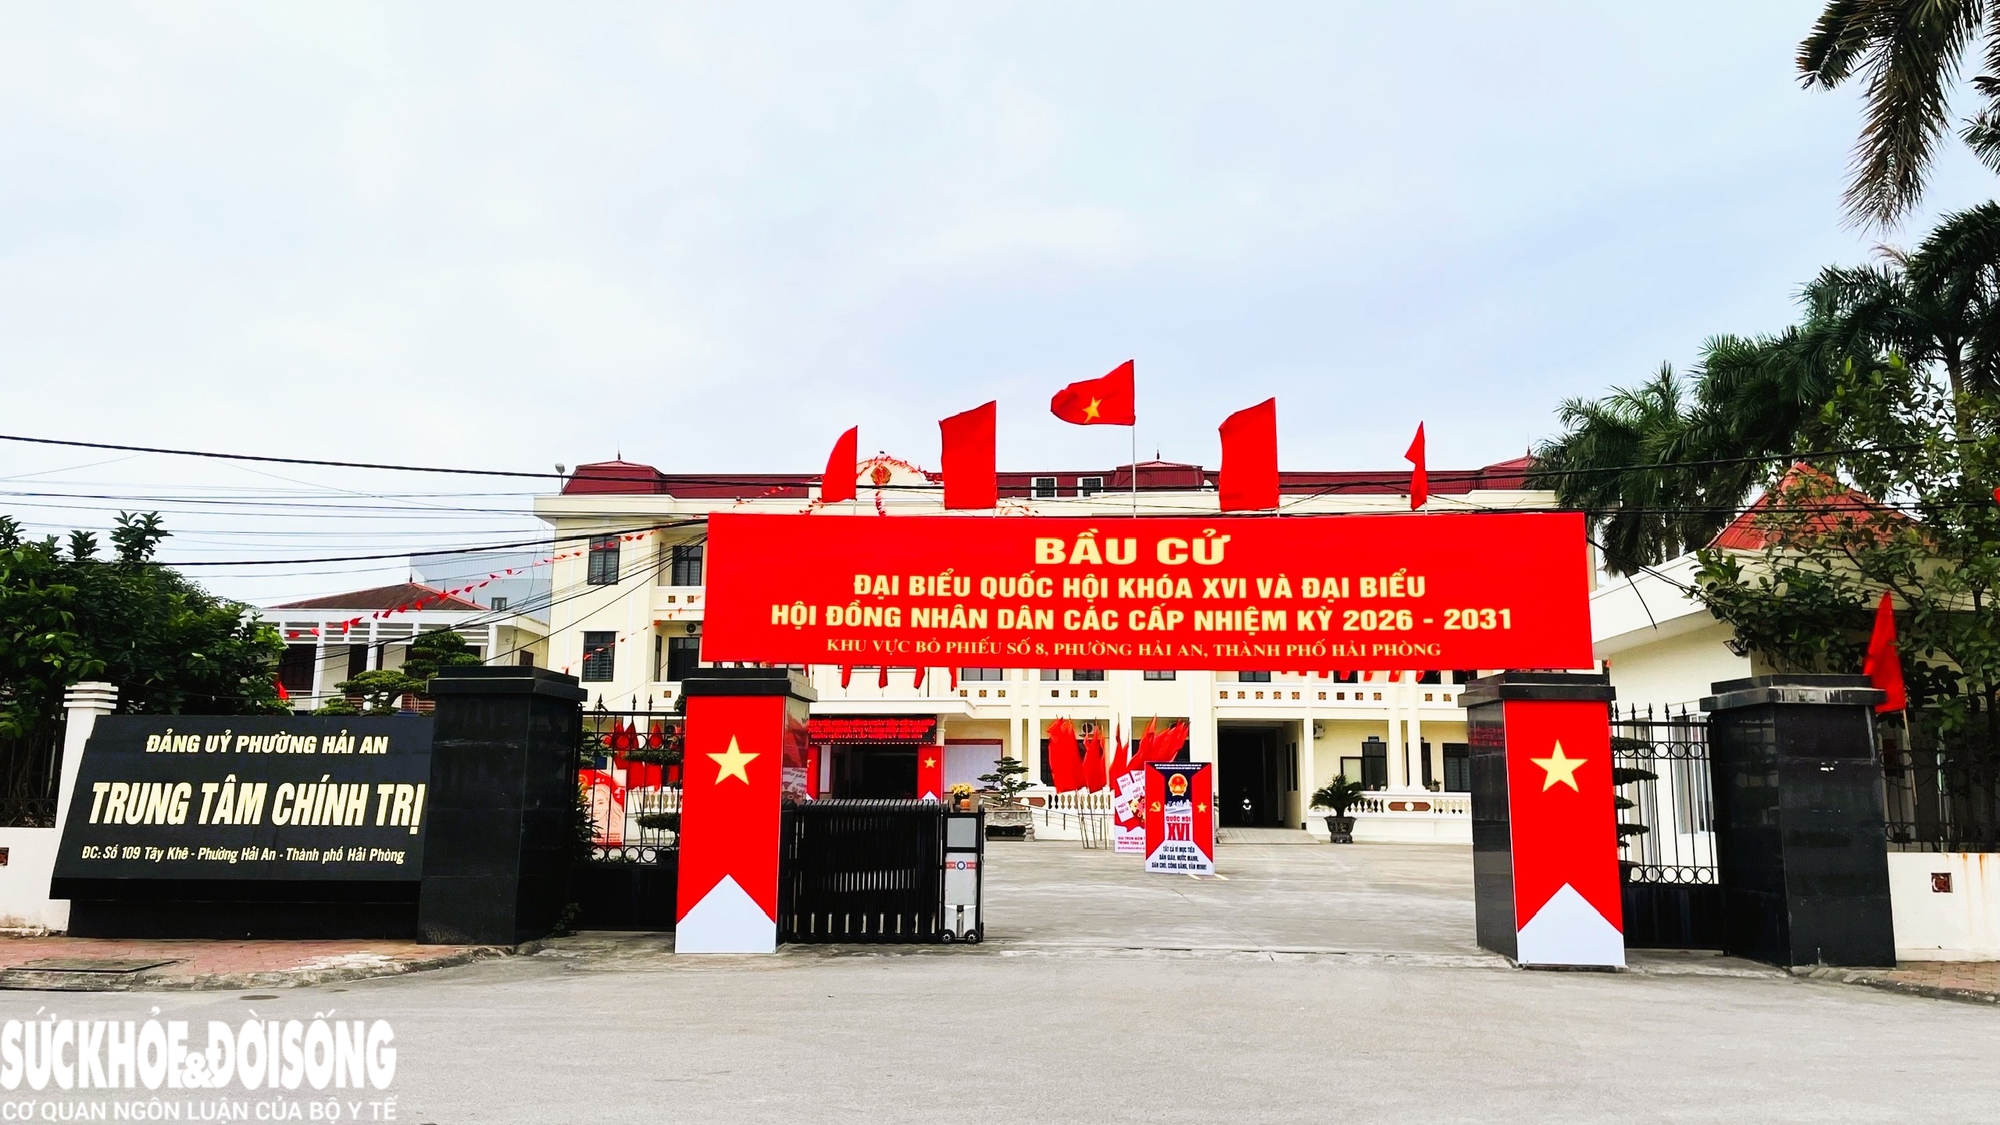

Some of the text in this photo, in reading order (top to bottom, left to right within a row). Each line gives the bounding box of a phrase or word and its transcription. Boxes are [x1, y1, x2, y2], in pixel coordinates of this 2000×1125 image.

[1034, 528, 1231, 565] BẦU CỬ
[853, 568, 1426, 602] ĐẠI BIỂU QUỐC HỘI KHÓA XVI VÀ ĐẠI BIỂU
[771, 601, 817, 630] HỘI
[826, 600, 901, 628] ĐỒNG
[910, 604, 988, 630] NHÂN
[997, 605, 1055, 631] DÂN
[1064, 606, 1119, 631] CÁC
[1128, 603, 1184, 631] CẤP
[1194, 606, 1287, 635] NHIỆM
[1297, 606, 1333, 632] KỲ
[1343, 609, 1413, 631] 2026
[1444, 608, 1512, 630] 2031
[827, 636, 1442, 658] KHU VỰC BỎ PHIẾU SỐ 8, PHƯỜNG HẢI AN, THÀNH PHỐ HẢI PHÒNG
[146, 728, 389, 754] ĐẢNG UỶ PHƯỜNG HẢI AN
[89, 773, 426, 835] TRUNG TÂM CHÍNH TRỊ
[1167, 823, 1190, 841] XVI
[82, 846, 102, 859] ĐC:
[103, 844, 119, 859] Số
[122, 846, 141, 859] 109
[144, 847, 165, 862] Tây
[167, 847, 189, 860] Khê
[198, 846, 238, 864] Phường
[241, 846, 259, 861] Hải
[261, 848, 277, 861] An
[286, 848, 320, 861] Thành
[322, 846, 344, 864] phố
[347, 847, 366, 861] Hải
[369, 848, 406, 864] Phòng
